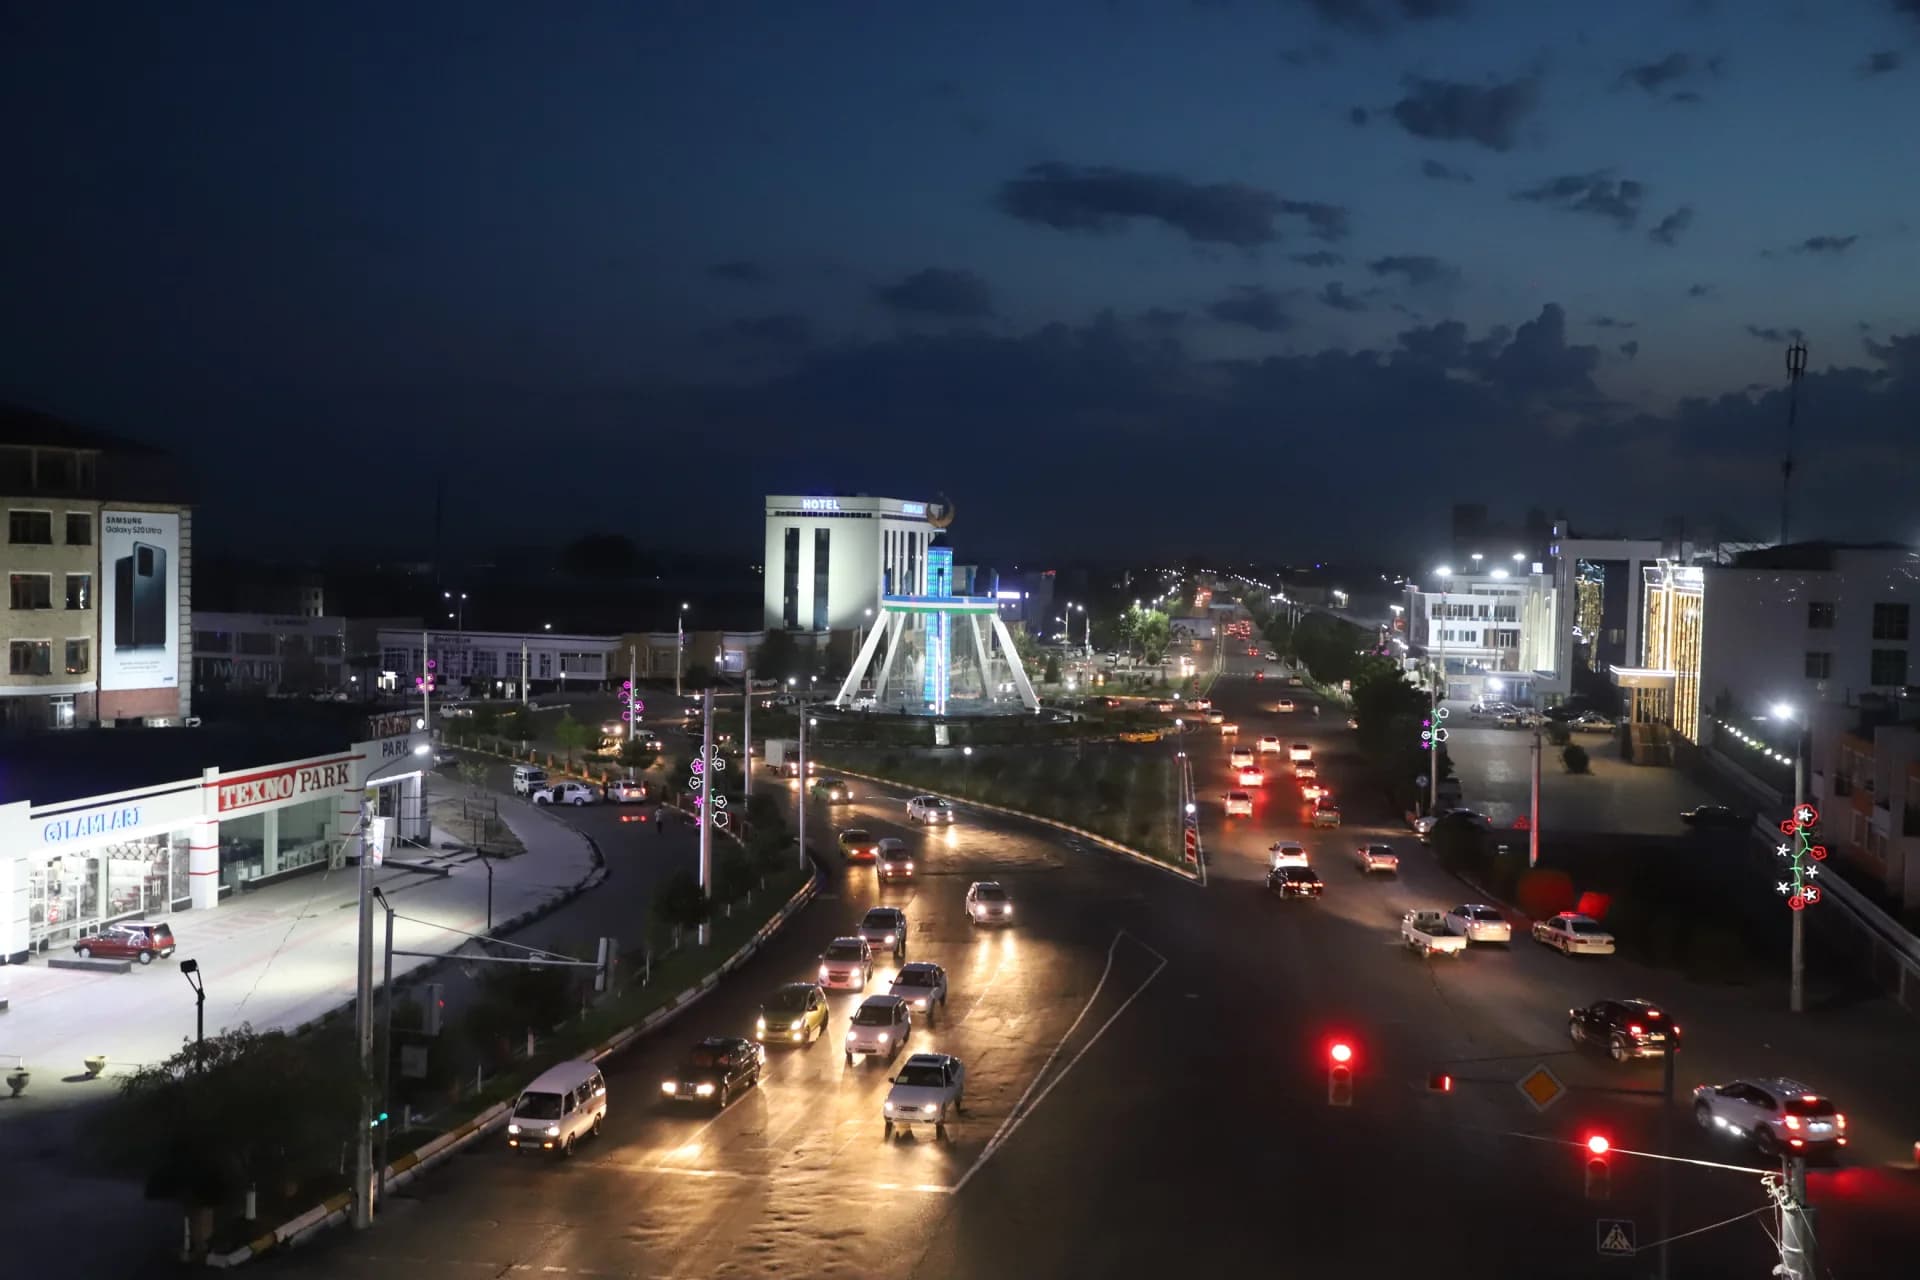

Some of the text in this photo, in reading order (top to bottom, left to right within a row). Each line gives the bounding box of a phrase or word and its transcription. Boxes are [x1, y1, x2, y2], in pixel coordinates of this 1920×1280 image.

[802, 498, 840, 510] HOTEL
[106, 516, 142, 525] SAMSUNG
[105, 525, 131, 535] Galaxy
[132, 526, 145, 534] S20
[382, 739, 409, 758] PARK
[221, 763, 351, 809] TEXNO PARK
